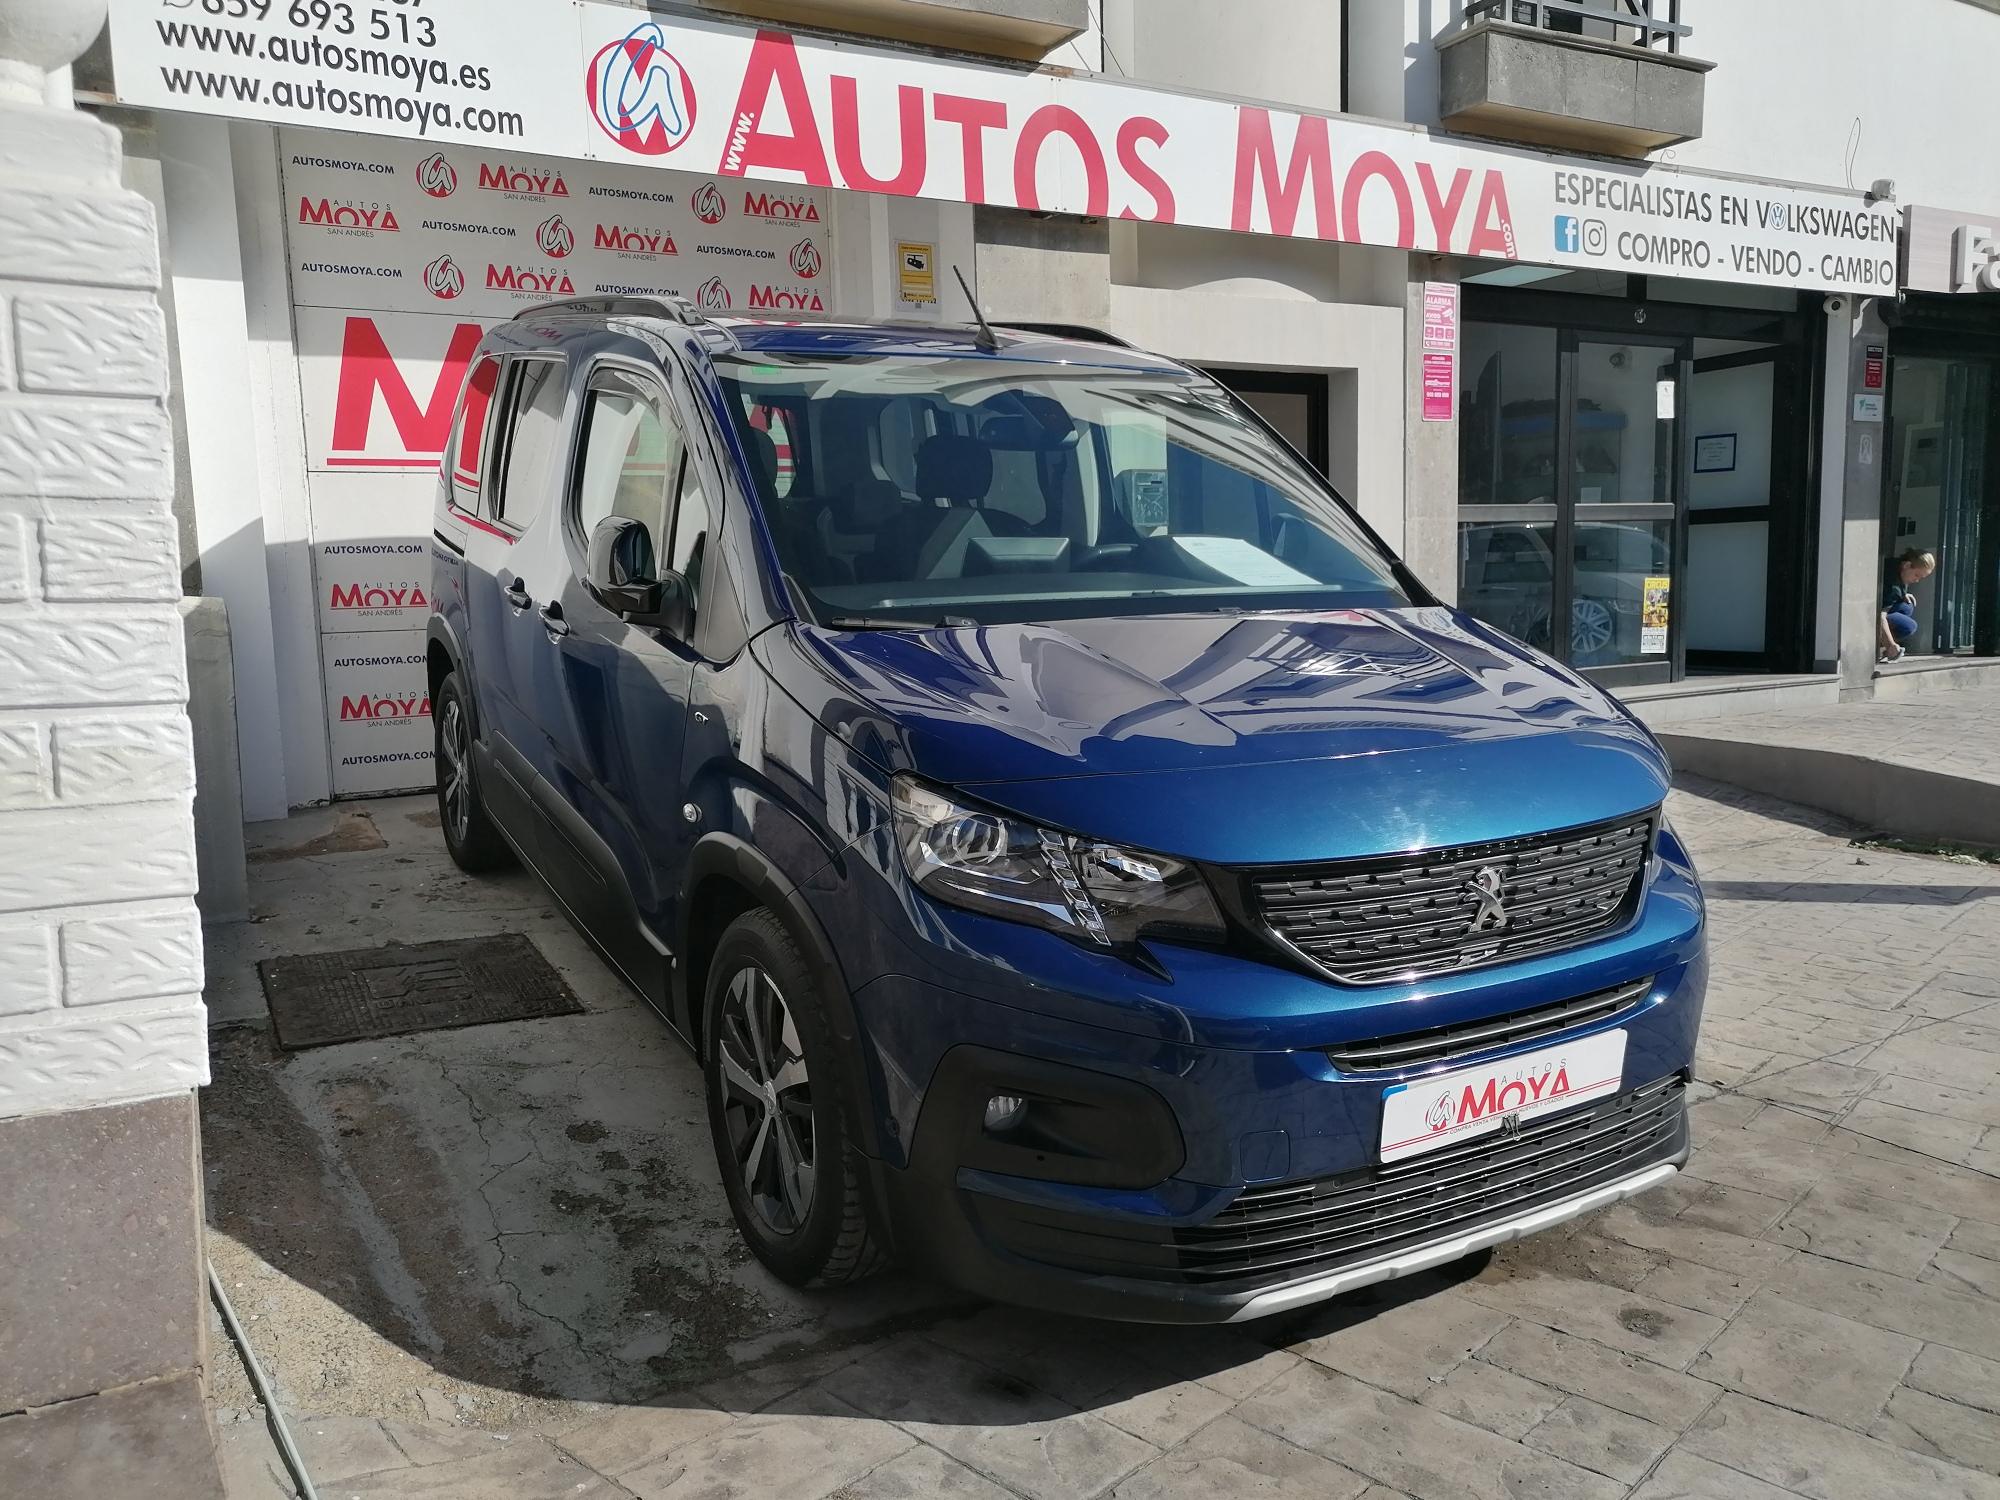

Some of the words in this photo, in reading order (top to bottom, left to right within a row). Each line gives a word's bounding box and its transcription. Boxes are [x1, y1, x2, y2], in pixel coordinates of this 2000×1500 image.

[288, 0, 355, 34] 693
[371, 9, 437, 48] 513
[155, 20, 491, 93] www.autosmoya.es
[160, 66, 524, 136] www.autosmoya.com
[718, 29, 1176, 225] AUTOS
[1231, 106, 1518, 260] MOYA
[725, 111, 756, 171] www.
[292, 156, 394, 175] AUTOSMOYA.COM
[509, 165, 562, 177] AUTOS
[479, 163, 569, 194] MOYA
[504, 193, 519, 201] SAN
[588, 187, 674, 203] AUTOSMOYA.COM
[769, 194, 814, 204] AUTOS
[1554, 171, 1712, 224] ESPECIALISTAS
[1720, 199, 1748, 227] EN
[299, 196, 399, 229] MOYA
[334, 199, 391, 211] AUTOS
[744, 191, 820, 220] MOYA
[422, 220, 516, 237] AUTOSMOYA.COM
[764, 218, 778, 226] SAN
[327, 228, 344, 236] SAN
[594, 224, 678, 254] MOYA
[622, 226, 671, 237] AUTOS
[1501, 219, 1517, 259] .com
[617, 252, 633, 260] SAN
[696, 244, 776, 260] AUTOSMOYA.COM
[1618, 231, 1710, 269] COMPRO
[1731, 244, 1801, 278] VENDO
[1821, 254, 1894, 287] CAMBIO
[301, 262, 402, 278] AUTOSMOYA.COM
[486, 264, 575, 292] MOYA
[516, 265, 568, 276] AUTOS
[511, 291, 526, 300] SAN
[595, 284, 679, 297] AUTOSMOYACOM
[749, 284, 824, 311] MOYA
[775, 285, 818, 295] AUTOS
[324, 545, 423, 555] AUTOSMOYA.COM
[364, 581, 420, 590] AUTOS
[331, 583, 428, 607] MOYA
[373, 690, 428, 701] AUTOS
[341, 695, 432, 719] MOYA
[367, 719, 383, 727] SAN
[1501, 1058, 1567, 1086] AUTOS
[1457, 1067, 1570, 1124] MOYA
